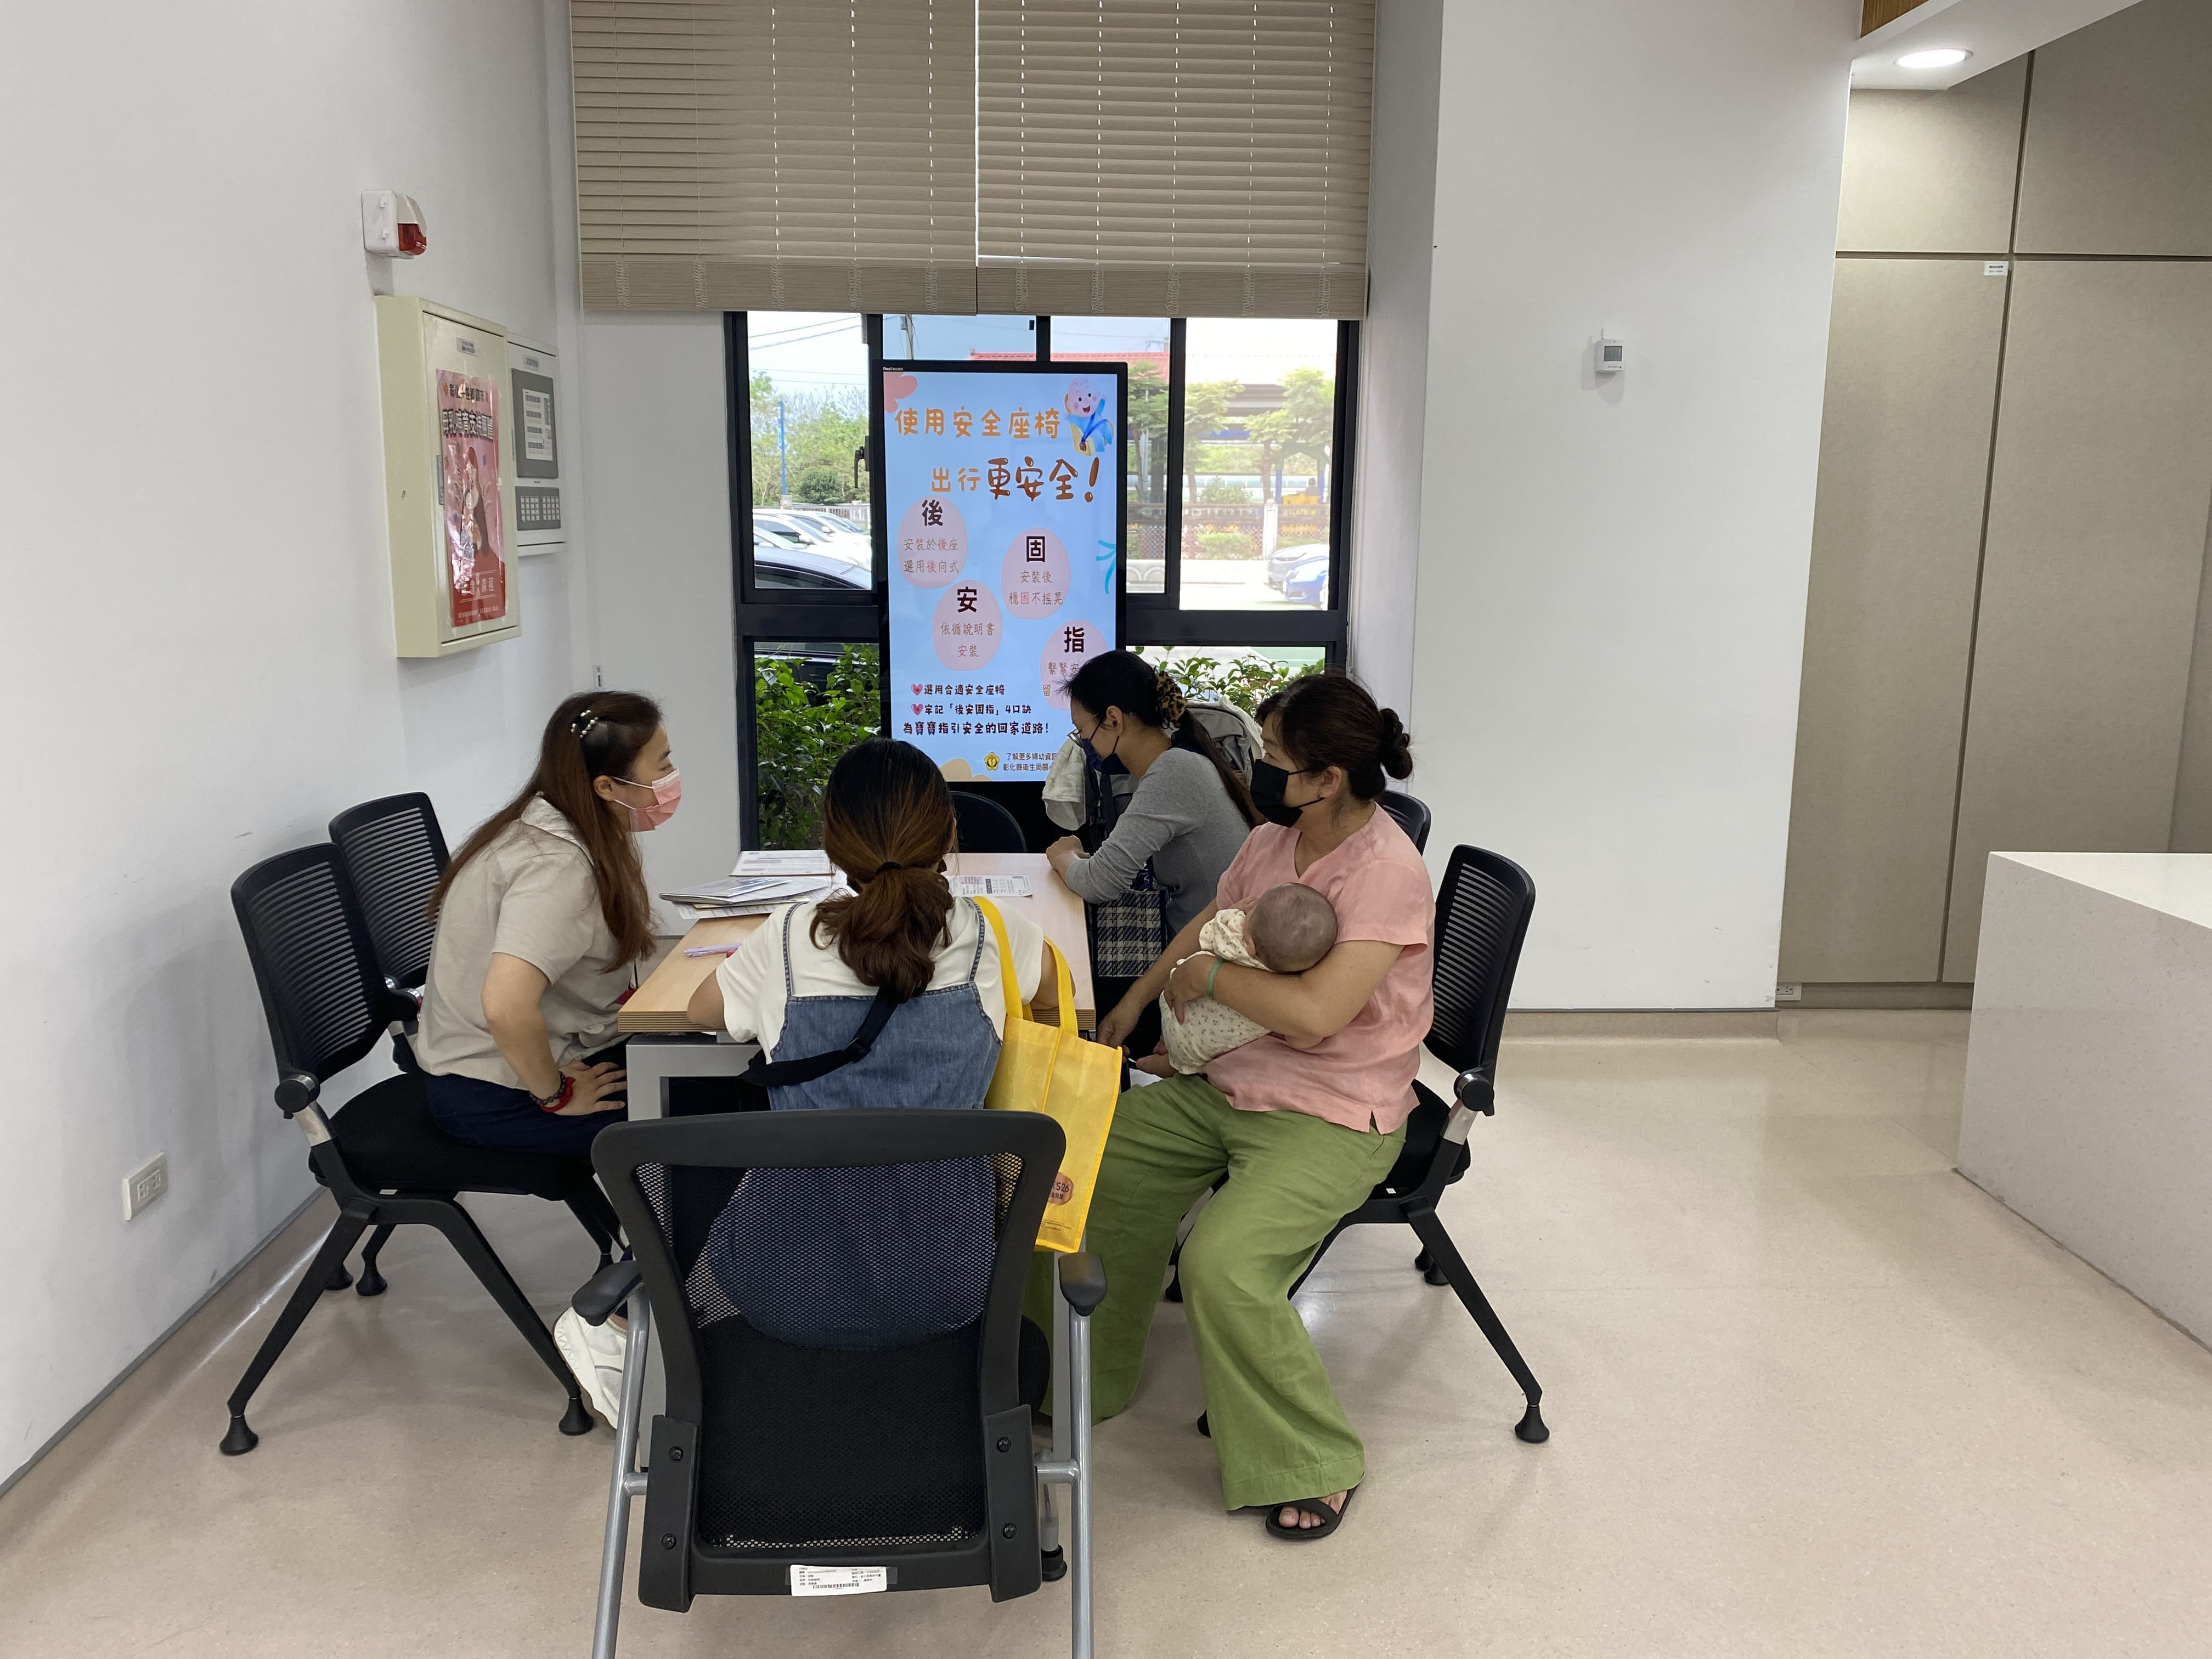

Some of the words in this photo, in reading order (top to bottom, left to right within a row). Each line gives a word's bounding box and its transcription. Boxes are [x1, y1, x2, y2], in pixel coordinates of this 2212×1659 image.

[894, 407, 1060, 439] 使用安全座椅
[931, 456, 1100, 503] 出行更安全!
[922, 499, 944, 527] 後
[904, 538, 959, 551] 安裝於後座
[1026, 535, 1046, 563] 固
[904, 560, 959, 573] 選用後向式
[1020, 571, 1053, 584] 安裝後
[957, 586, 978, 613] 安
[1008, 592, 1064, 606] 穩固不搖晃
[940, 622, 995, 636] 依循說明書
[1064, 627, 1085, 653] 指
[957, 645, 979, 658] 安裝
[924, 684, 1005, 696] 選用合適安全座椅
